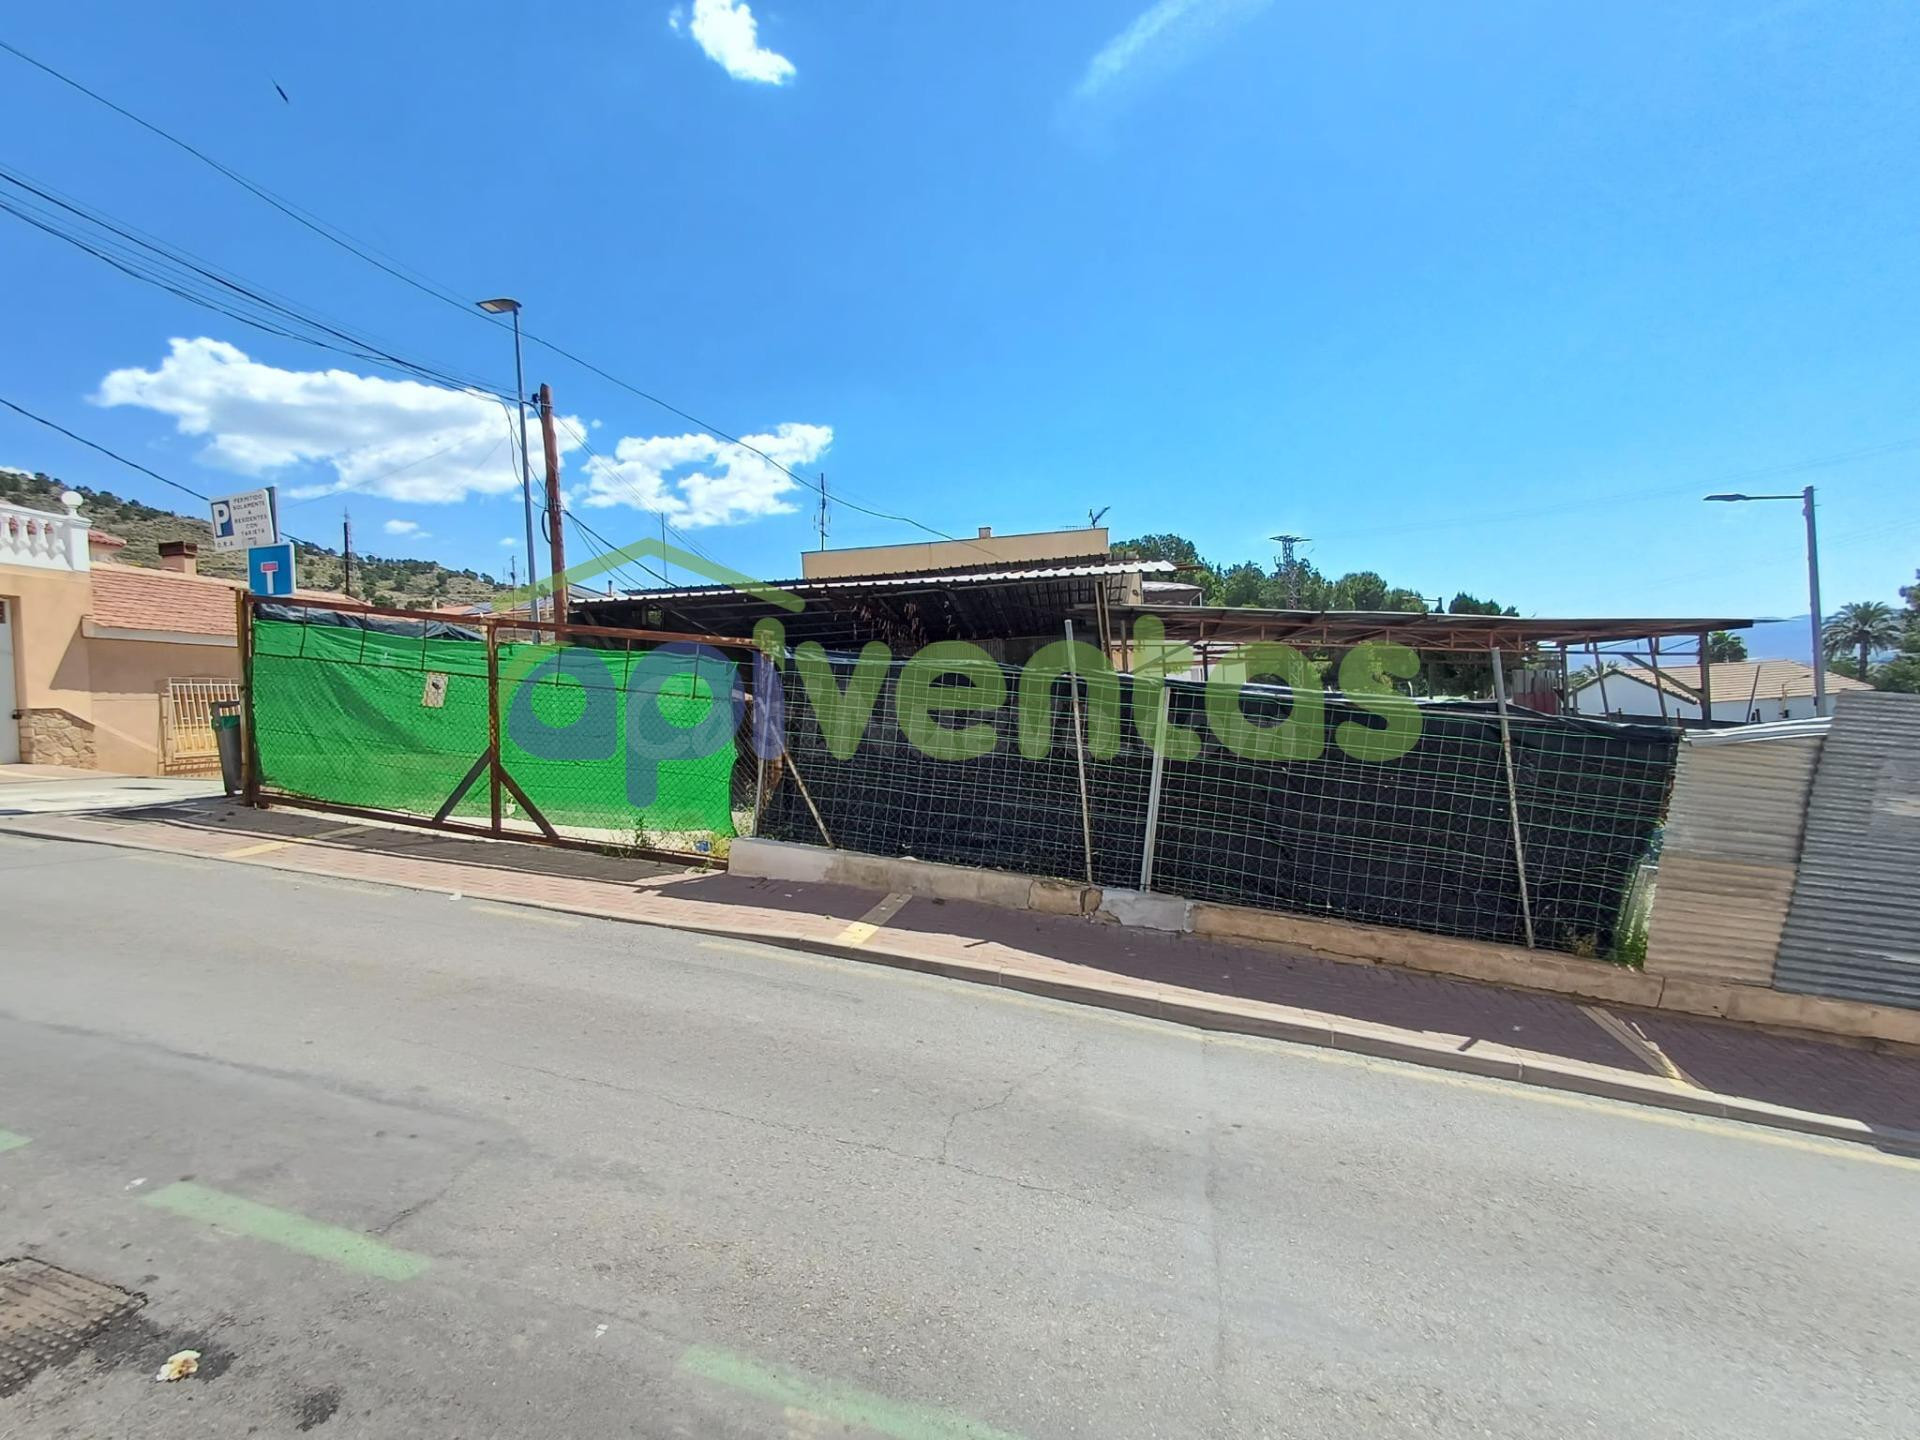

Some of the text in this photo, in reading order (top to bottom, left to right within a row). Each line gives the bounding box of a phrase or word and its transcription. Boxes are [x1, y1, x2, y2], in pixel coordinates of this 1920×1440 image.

[233, 494, 263, 503] PERMITIDO
[232, 501, 265, 510] SOLAMENTE
[212, 503, 230, 537] P
[234, 515, 267, 523] RESIDENTES
